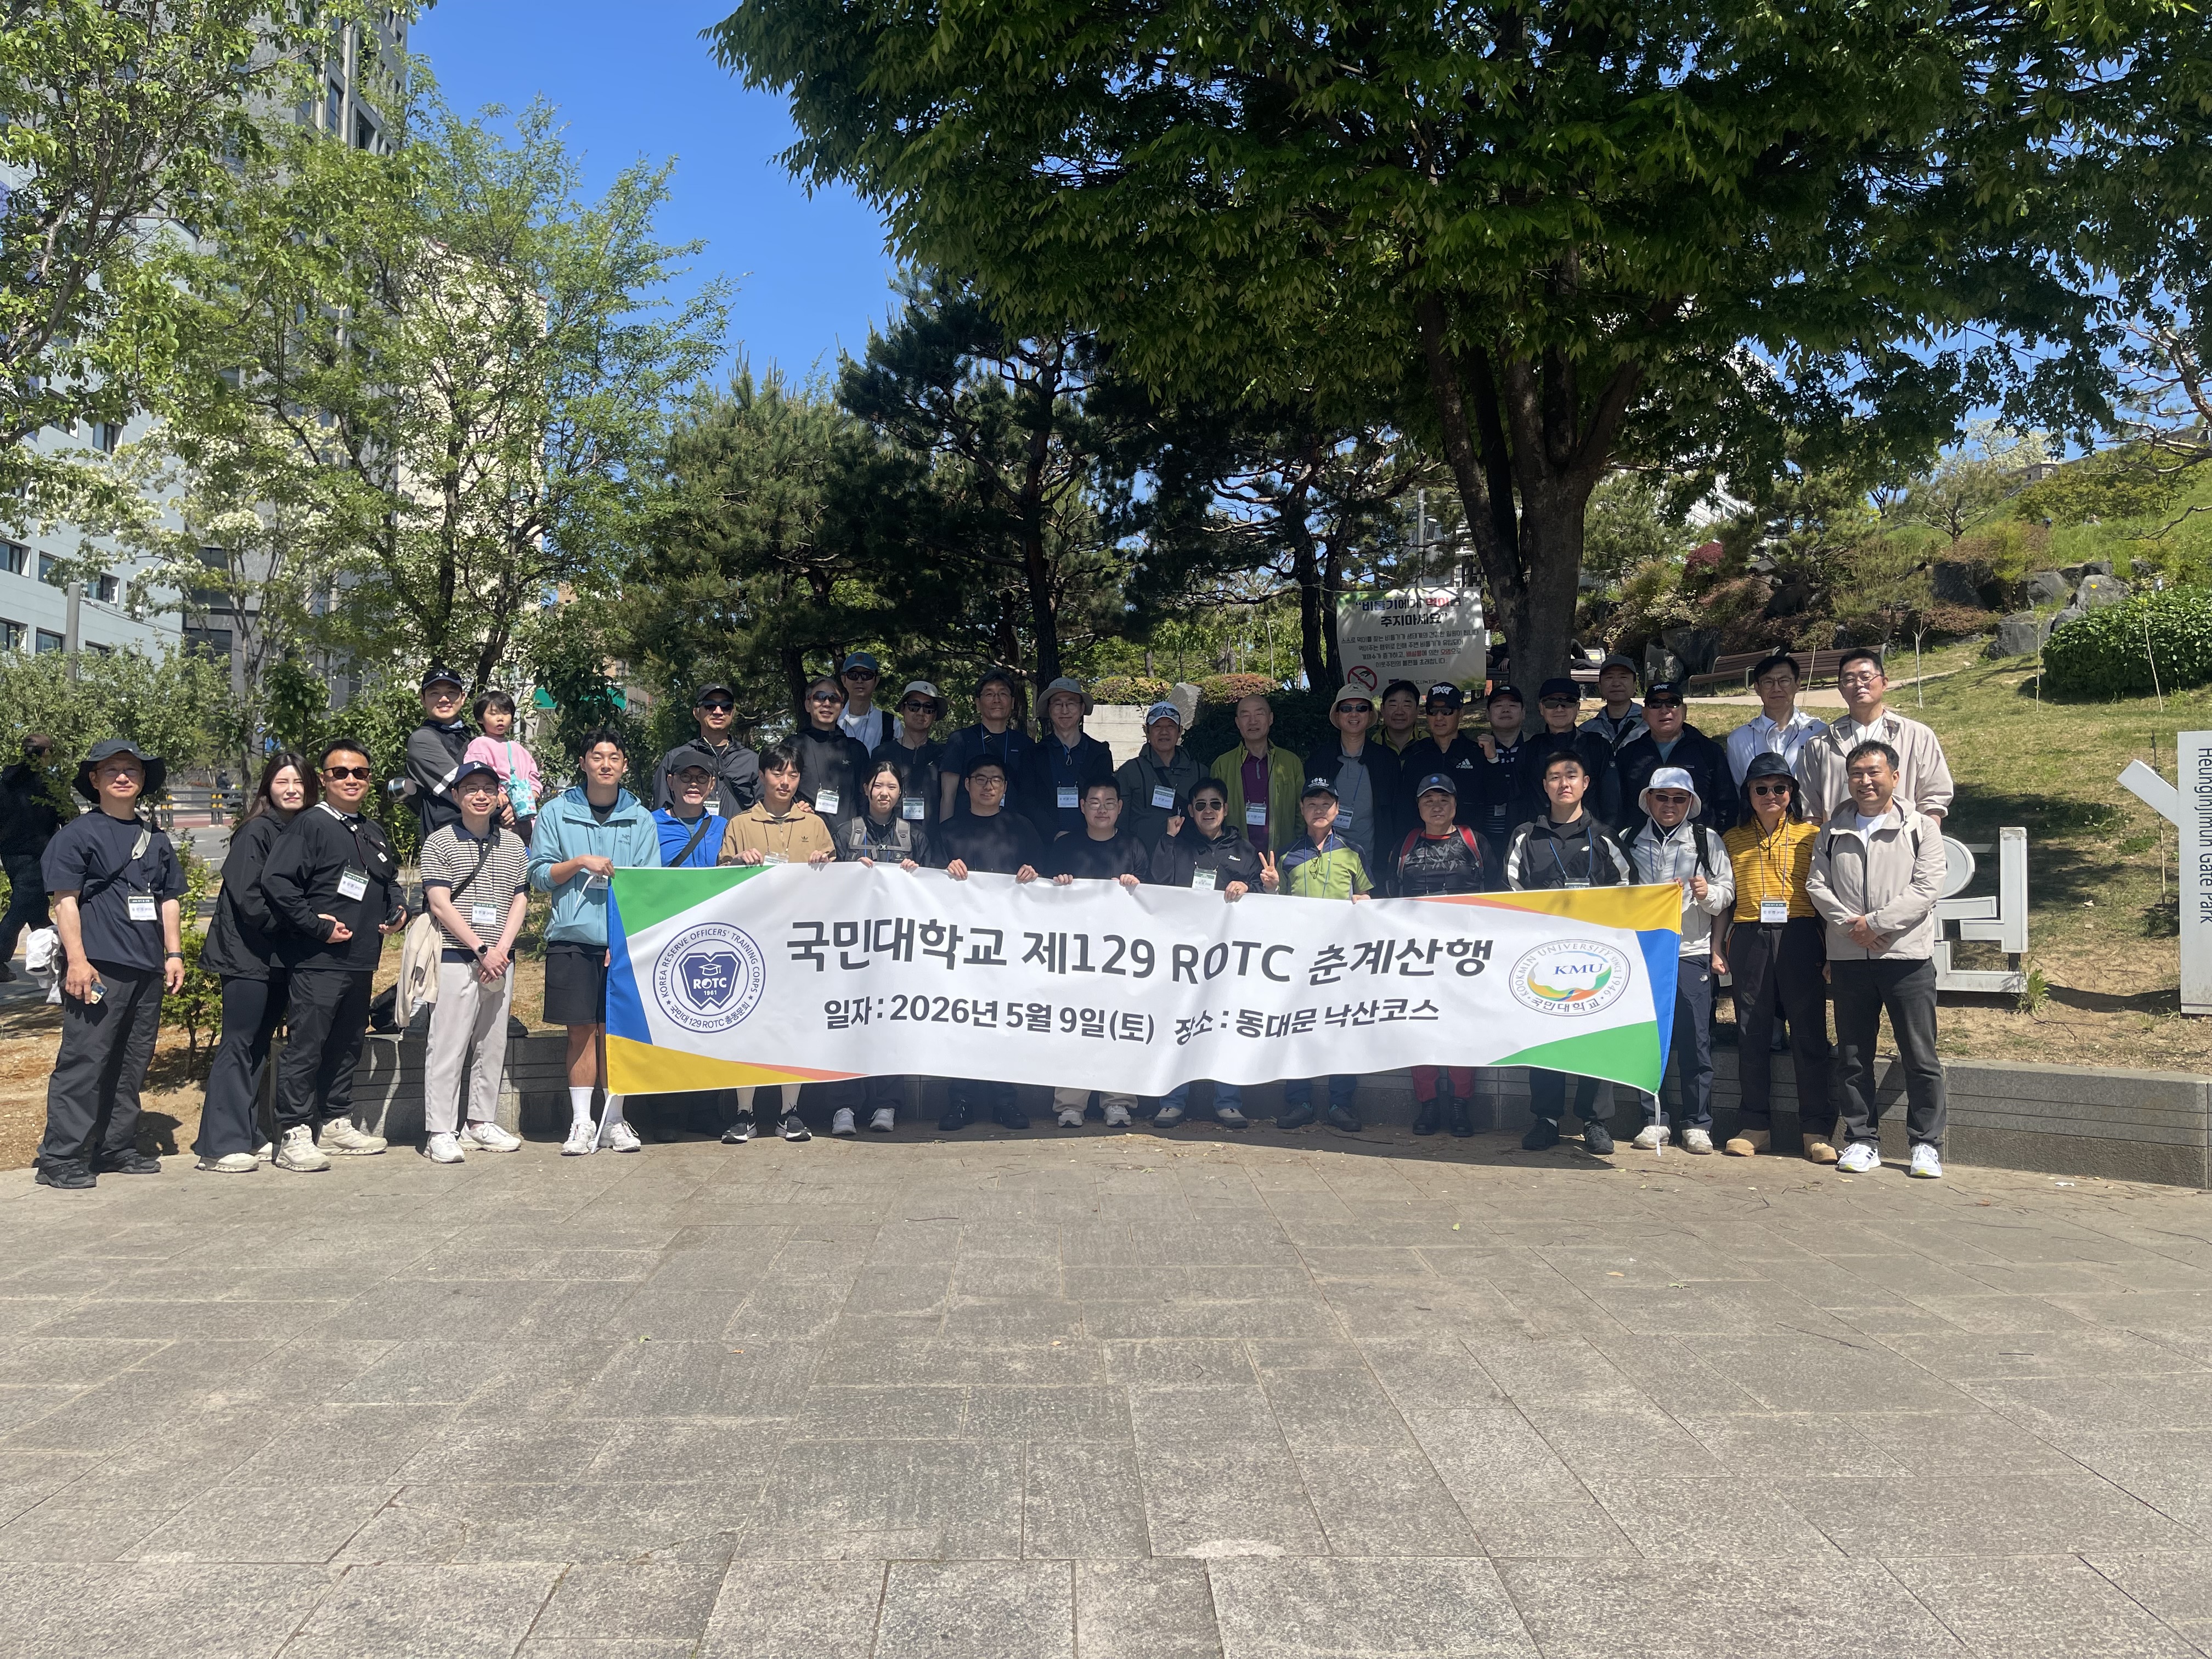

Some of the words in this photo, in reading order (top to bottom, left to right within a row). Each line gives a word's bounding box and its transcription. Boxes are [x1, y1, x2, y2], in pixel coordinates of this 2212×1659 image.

[662, 937, 689, 967] RESERVE
[731, 932, 758, 964] TRAINING
[786, 917, 1007, 972] 국민대학교
[1022, 932, 1155, 978] 제129
[1172, 941, 1295, 984] ROTC
[1308, 938, 1493, 986] 춘계산행
[1538, 943, 1613, 956] UNIVERSITY
[1515, 955, 1536, 997] KOOKMIN
[1553, 963, 1604, 975] KMU
[1610, 956, 1622, 973] SINCE
[659, 969, 669, 998] KOREA
[693, 977, 727, 989] ROTC
[751, 966, 760, 993] CORPS
[1603, 975, 1622, 997] 1946
[670, 1004, 690, 1024] 국민대
[689, 1018, 702, 1028] 129
[702, 1018, 724, 1029] ROTC
[724, 1001, 751, 1024] 총동문회
[1006, 1002, 1052, 1033] 5월
[1324, 998, 1440, 1028] 낙산코스
[1531, 997, 1601, 1012] 국민대학교
